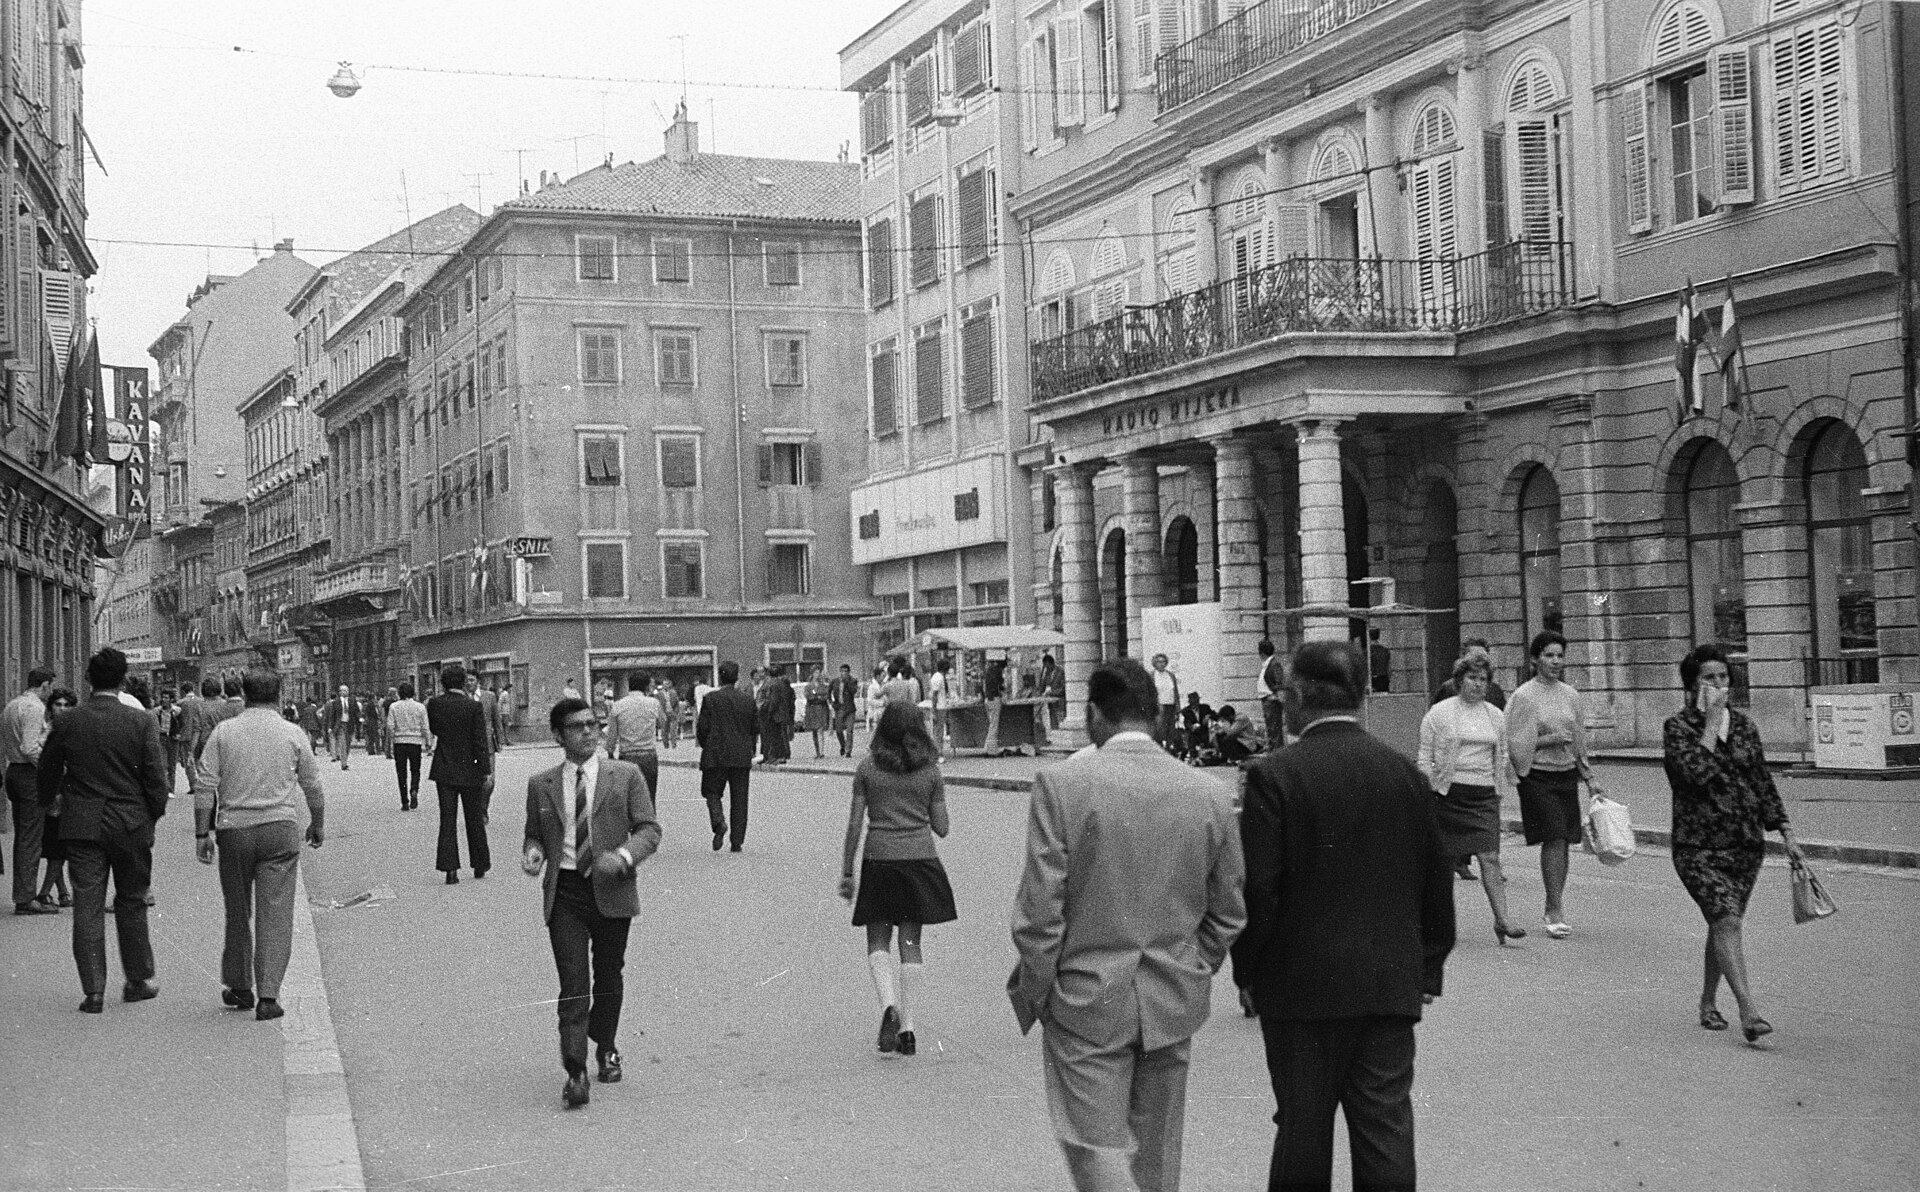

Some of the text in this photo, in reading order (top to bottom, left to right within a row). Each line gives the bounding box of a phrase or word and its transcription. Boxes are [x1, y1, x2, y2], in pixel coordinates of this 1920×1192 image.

[127, 380, 146, 507] KAVANA
[1103, 383, 1240, 434] RADIO RIJEKA
